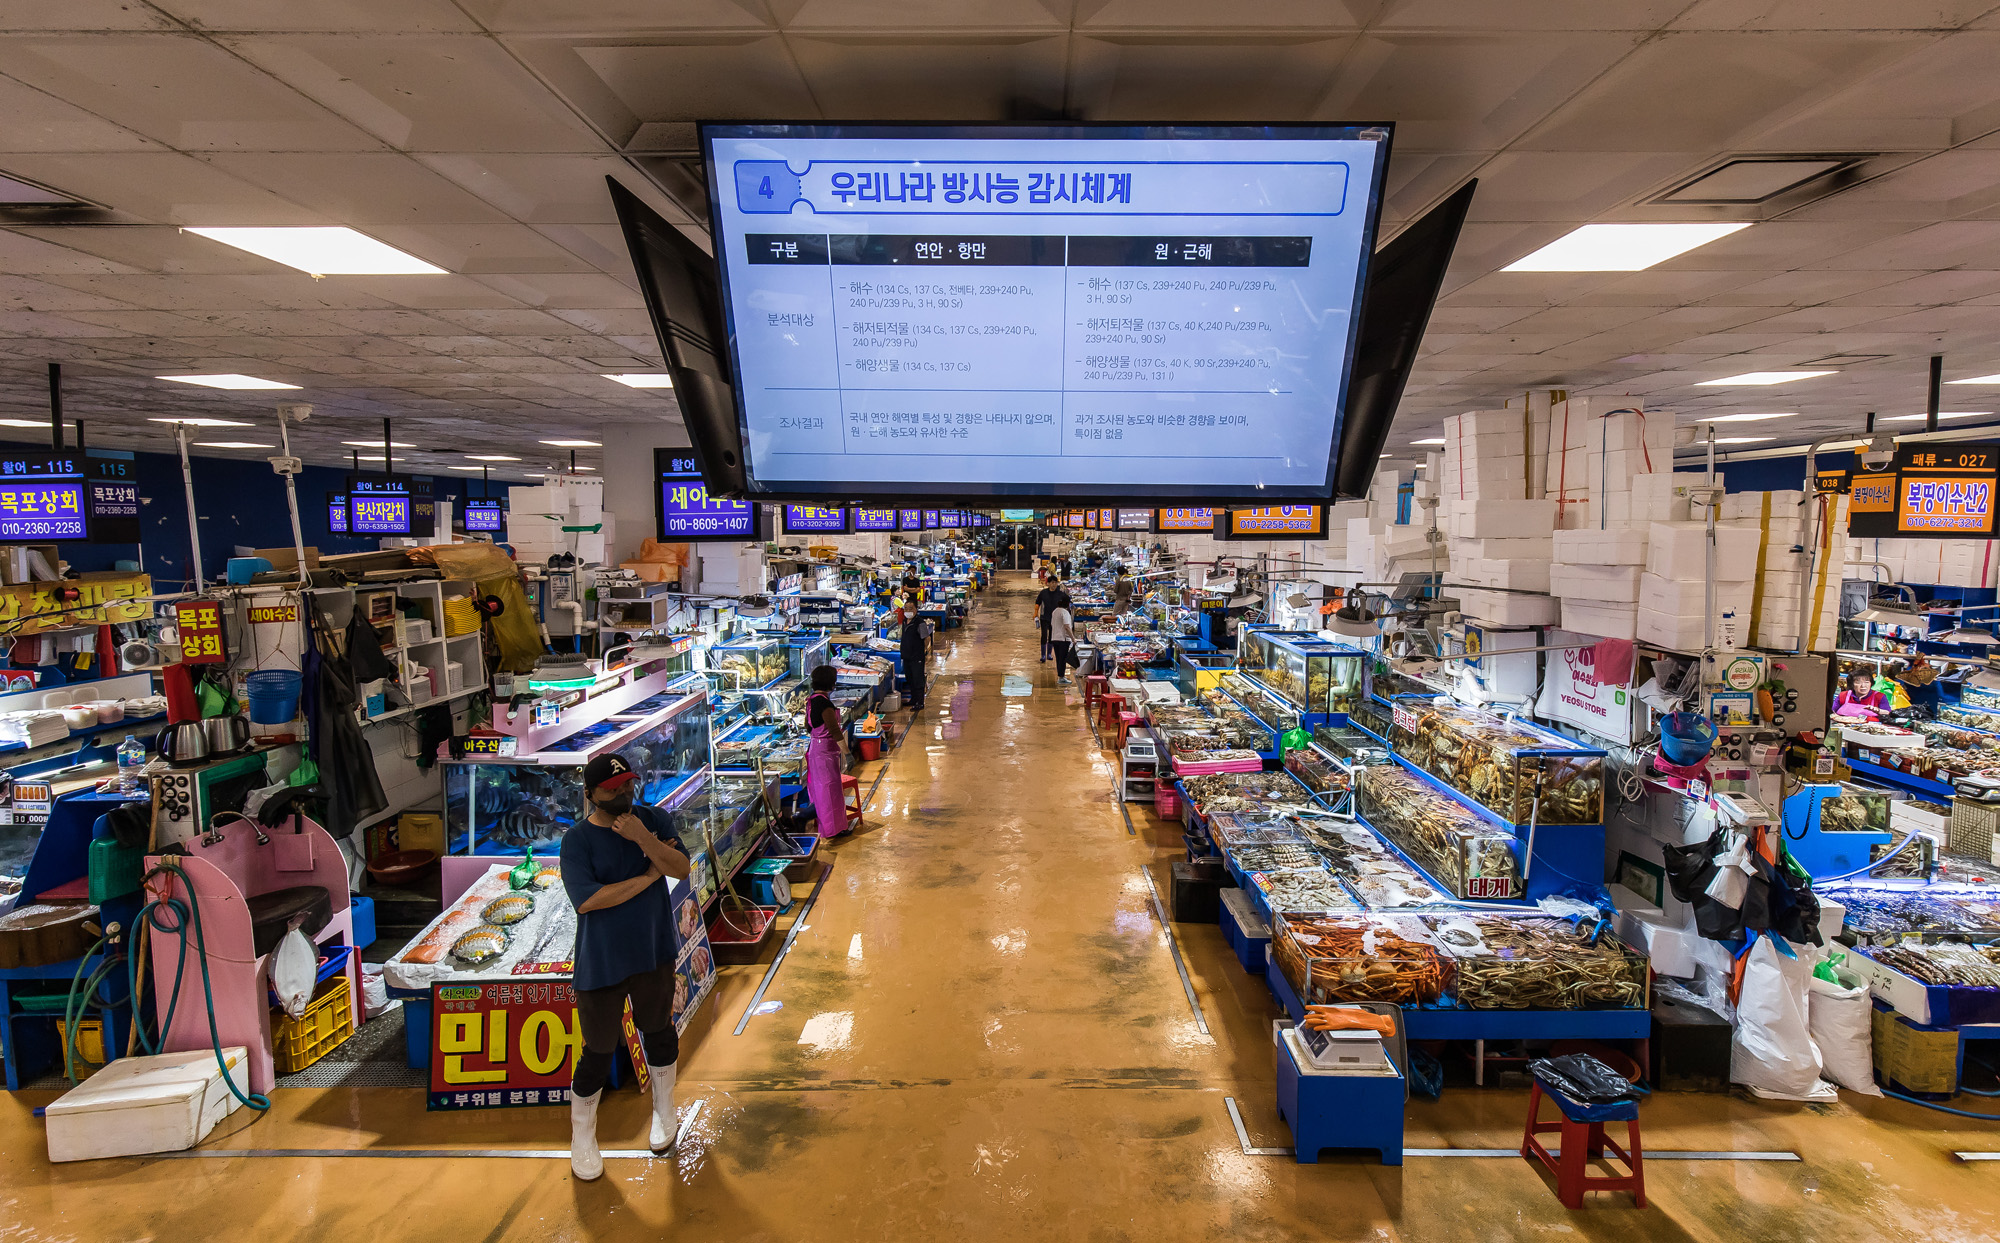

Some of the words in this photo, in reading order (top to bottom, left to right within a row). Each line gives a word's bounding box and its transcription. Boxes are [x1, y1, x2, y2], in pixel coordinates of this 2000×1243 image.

[758, 175, 774, 200] 4
[830, 172, 936, 204] 우리나라
[942, 172, 1020, 204] 방사능
[1029, 172, 1132, 204] 감시체계
[770, 242, 799, 259] 구분
[914, 242, 944, 259] 연안
[958, 242, 986, 259] 항만
[1154, 243, 1169, 260] 원
[1182, 243, 1212, 260] 근해
[850, 282, 873, 296] 해수
[876, 285, 895, 296] (134
[898, 285, 912, 296] Cs,
[914, 285, 930, 296] 137
[932, 285, 946, 296] Cs,
[950, 285, 977, 296] 전베타,
[980, 285, 1017, 296] 239+240
[1020, 285, 1034, 296] Pu,
[1088, 277, 1111, 291] 해수
[1115, 281, 1134, 291] (137
[1136, 281, 1150, 291] Cs,
[1153, 281, 1191, 291] 239+240
[1194, 281, 1207, 291] Pu,
[1210, 281, 1226, 291] 240
[1229, 281, 1260, 291] Pu/239
[1263, 281, 1277, 291] Pu,
[850, 299, 866, 309] 240
[868, 299, 900, 309] Pu/239
[903, 299, 915, 309] Pu,
[918, 299, 923, 309] 3
[926, 299, 935, 309] H,
[938, 299, 949, 309] 90
[951, 299, 963, 309] Sr)
[1087, 295, 1092, 304] 3
[1095, 295, 1104, 304] H,
[1107, 295, 1117, 304] 90
[1120, 295, 1132, 304] Sr)
[768, 312, 814, 328] 분석대상
[1087, 318, 1144, 332] 해저퇴적물
[1147, 322, 1166, 332] (137
[1169, 322, 1182, 332] Cs,
[1185, 322, 1195, 332] 40
[1198, 322, 1222, 332] K,240
[1225, 322, 1256, 332] Pu/239
[1259, 322, 1272, 332] Pu,
[853, 322, 909, 335] 해저퇴적물
[913, 326, 931, 336] (134
[934, 326, 947, 336] Cs,
[950, 326, 965, 336] 137
[968, 326, 982, 336] Cs,
[984, 326, 1021, 336] 239+240
[1024, 326, 1037, 336] Pu,
[853, 338, 869, 348] 240
[871, 338, 901, 348] Pu/239
[904, 338, 918, 348] Pu)
[1086, 335, 1123, 344] 239+240
[1126, 335, 1138, 344] Pu,
[1141, 335, 1152, 344] 90
[1154, 335, 1166, 344] Sr)
[856, 359, 899, 372] 해양생물
[903, 362, 922, 372] (134
[924, 362, 937, 372] Cs,
[940, 362, 954, 372] 137
[957, 362, 971, 372] Cs)
[1086, 356, 1130, 369] 해양생물
[1134, 358, 1152, 368] (137
[1155, 358, 1168, 368] Cs,
[1170, 358, 1181, 368] 40
[1184, 358, 1191, 368] K,
[1194, 358, 1205, 368] 90
[1207, 358, 1255, 368] Sr,239+240
[1258, 358, 1271, 368] Pu,
[1084, 371, 1100, 380] 240
[1103, 371, 1132, 380] Pu/239
[1135, 371, 1148, 380] Pu,
[1151, 371, 1166, 380] 131
[779, 417, 824, 430] 조사결과
[850, 412, 868, 424] 국내
[870, 412, 889, 424] 연안
[892, 412, 919, 424] 해역별
[922, 412, 940, 424] 특성
[943, 412, 952, 424] 및
[956, 412, 982, 424] 경향은
[986, 412, 1022, 424] 나타나지
[1025, 412, 1055, 424] 않으며,
[1075, 415, 1093, 426] 과거
[1096, 415, 1124, 426] 조사된
[1127, 415, 1154, 426] 농도와
[1158, 415, 1185, 426] 비슷한
[1188, 415, 1215, 426] 경향을
[1219, 415, 1249, 426] 보이며,
[851, 427, 860, 438] 원
[869, 427, 888, 438] 근해
[890, 427, 917, 438] 농도와
[920, 427, 947, 438] 유사한
[950, 427, 968, 438] 수준
[1075, 429, 1102, 439] 특이점
[1105, 429, 1123, 439] 없음
[2, 461, 26, 474] 활어
[48, 460, 73, 472] 115
[672, 459, 695, 471] 활어
[1913, 454, 1936, 466] 패류
[1959, 455, 1987, 466] 027
[100, 463, 126, 476] 115
[1822, 479, 1838, 488] 038
[94, 487, 136, 502] 목포상회
[1908, 482, 1988, 514] 복띵이수산2
[1, 490, 78, 514] 목포상회
[95, 506, 137, 515] 010-2360-2258
[356, 502, 404, 521] 부산자갈치
[416, 504, 434, 515] 부산자갈치
[2, 522, 81, 535] 010-2360-2258
[670, 518, 748, 531] 010-8609-1407
[1240, 520, 1311, 530] 010-2258-5362
[1907, 517, 1983, 528] 010-6272-3214
[179, 609, 217, 630] 목포
[182, 635, 221, 658] 상회
[1561, 694, 1584, 708] YEOSU
[1585, 702, 1606, 717] STORE
[1394, 708, 1415, 732] 킹크랩
[610, 759, 626, 774] A
[1468, 877, 1510, 897] 대게
[444, 988, 479, 999] 자연산
[487, 985, 523, 1005] 여름철
[528, 984, 550, 1004] 인기
[445, 1001, 476, 1011] 국내산
[440, 1008, 583, 1084] 민어
[454, 1090, 502, 1106] 부위별
[509, 1089, 540, 1104] 분할
